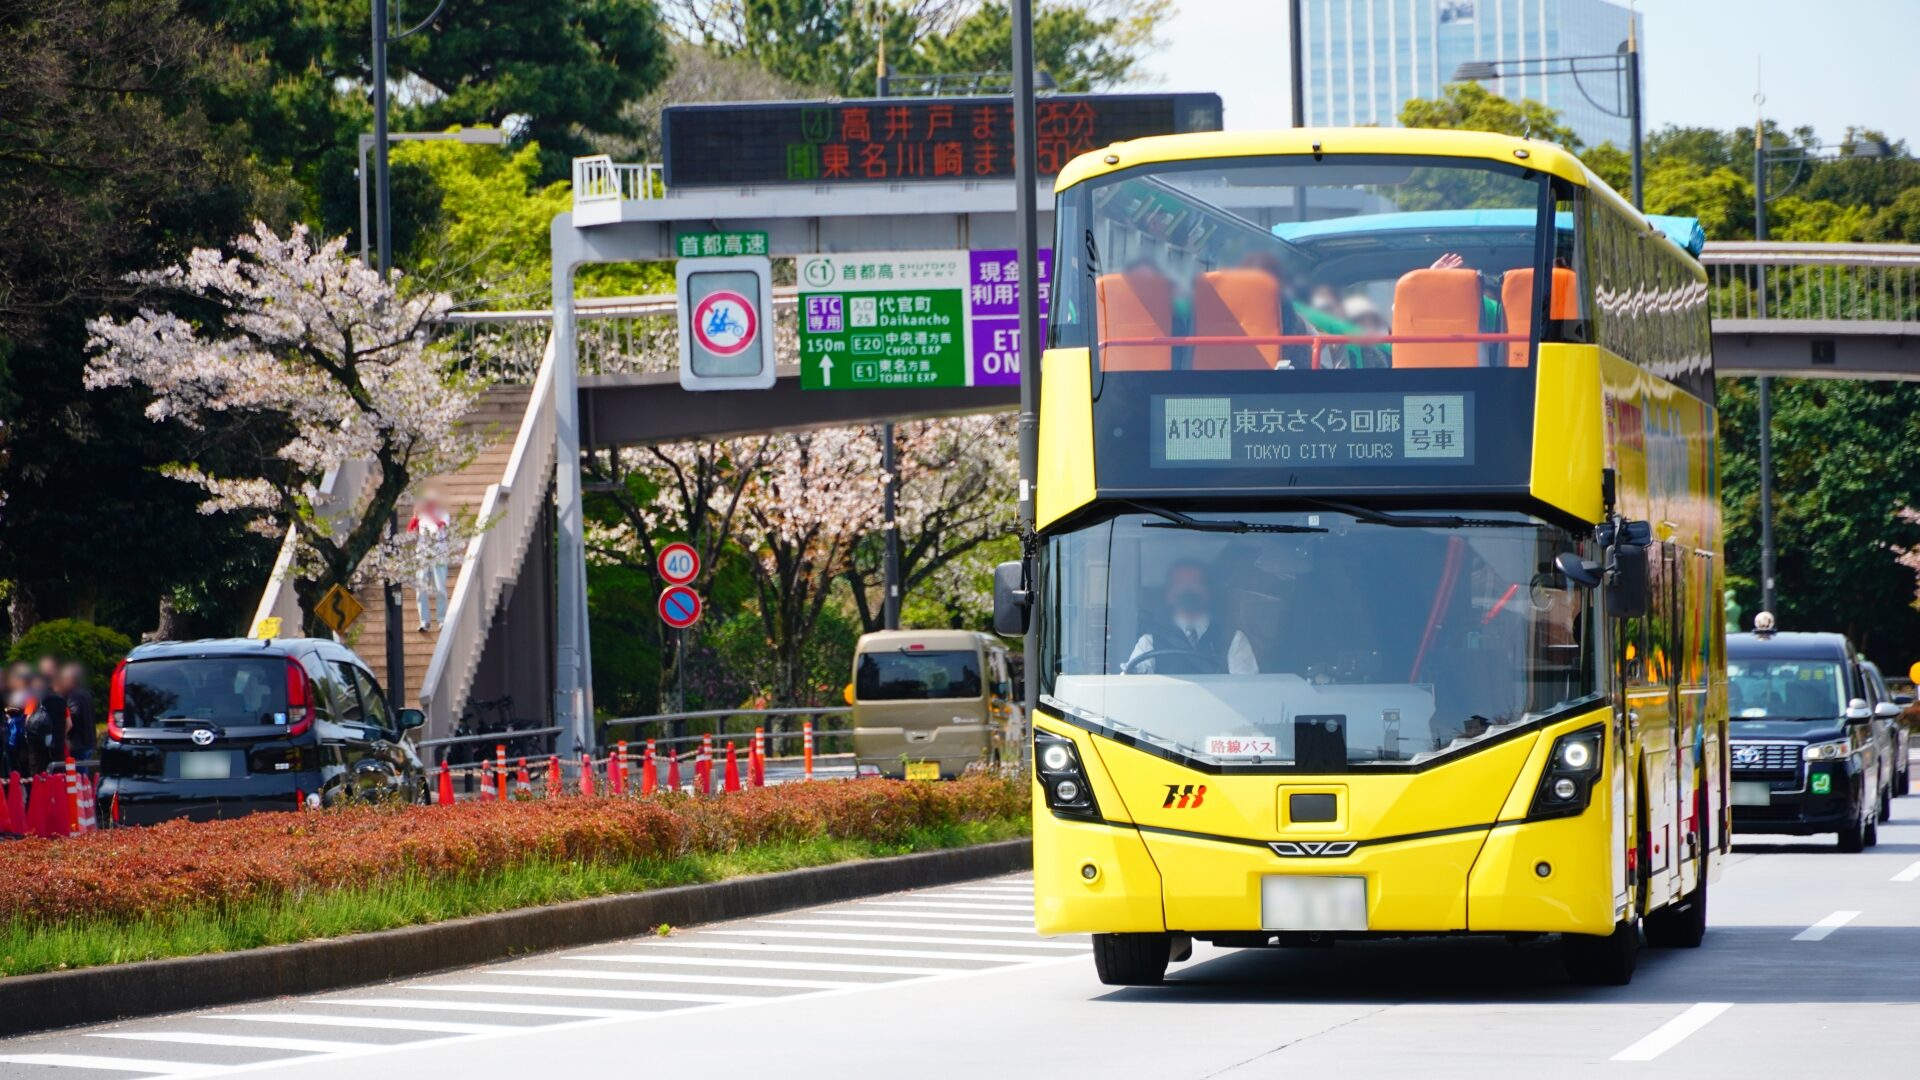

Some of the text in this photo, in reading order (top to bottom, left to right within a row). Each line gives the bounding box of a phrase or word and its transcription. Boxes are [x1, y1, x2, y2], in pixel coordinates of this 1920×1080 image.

[681, 233, 765, 256] 首都高速
[843, 264, 893, 281] 首都高
[899, 262, 957, 270] SHUTOKO
[972, 282, 1050, 305] 利用可
[809, 298, 841, 314] ETC
[853, 301, 874, 311] 入口
[879, 297, 932, 313] 代官町
[810, 315, 841, 330] 専用
[857, 314, 871, 324] 25
[880, 314, 950, 326] Daikancho
[807, 338, 846, 352] 150m
[853, 337, 882, 351] E20
[885, 332, 952, 345] 中央道方面
[993, 329, 1020, 351] ET
[886, 345, 942, 356] CHUO EXP
[879, 359, 931, 373] 東名方面
[983, 352, 1020, 374] ON
[856, 365, 873, 378] E1
[879, 373, 937, 384] TOMEI EXP
[1233, 408, 1400, 434] 東京さくら回廊
[1422, 403, 1446, 424] 31
[1168, 418, 1228, 439] A1307
[1410, 429, 1455, 450] 号車
[1244, 443, 1393, 460] TOKYO CITY TOURS
[667, 555, 691, 573] 40
[1211, 739, 1273, 754] 路線バス
